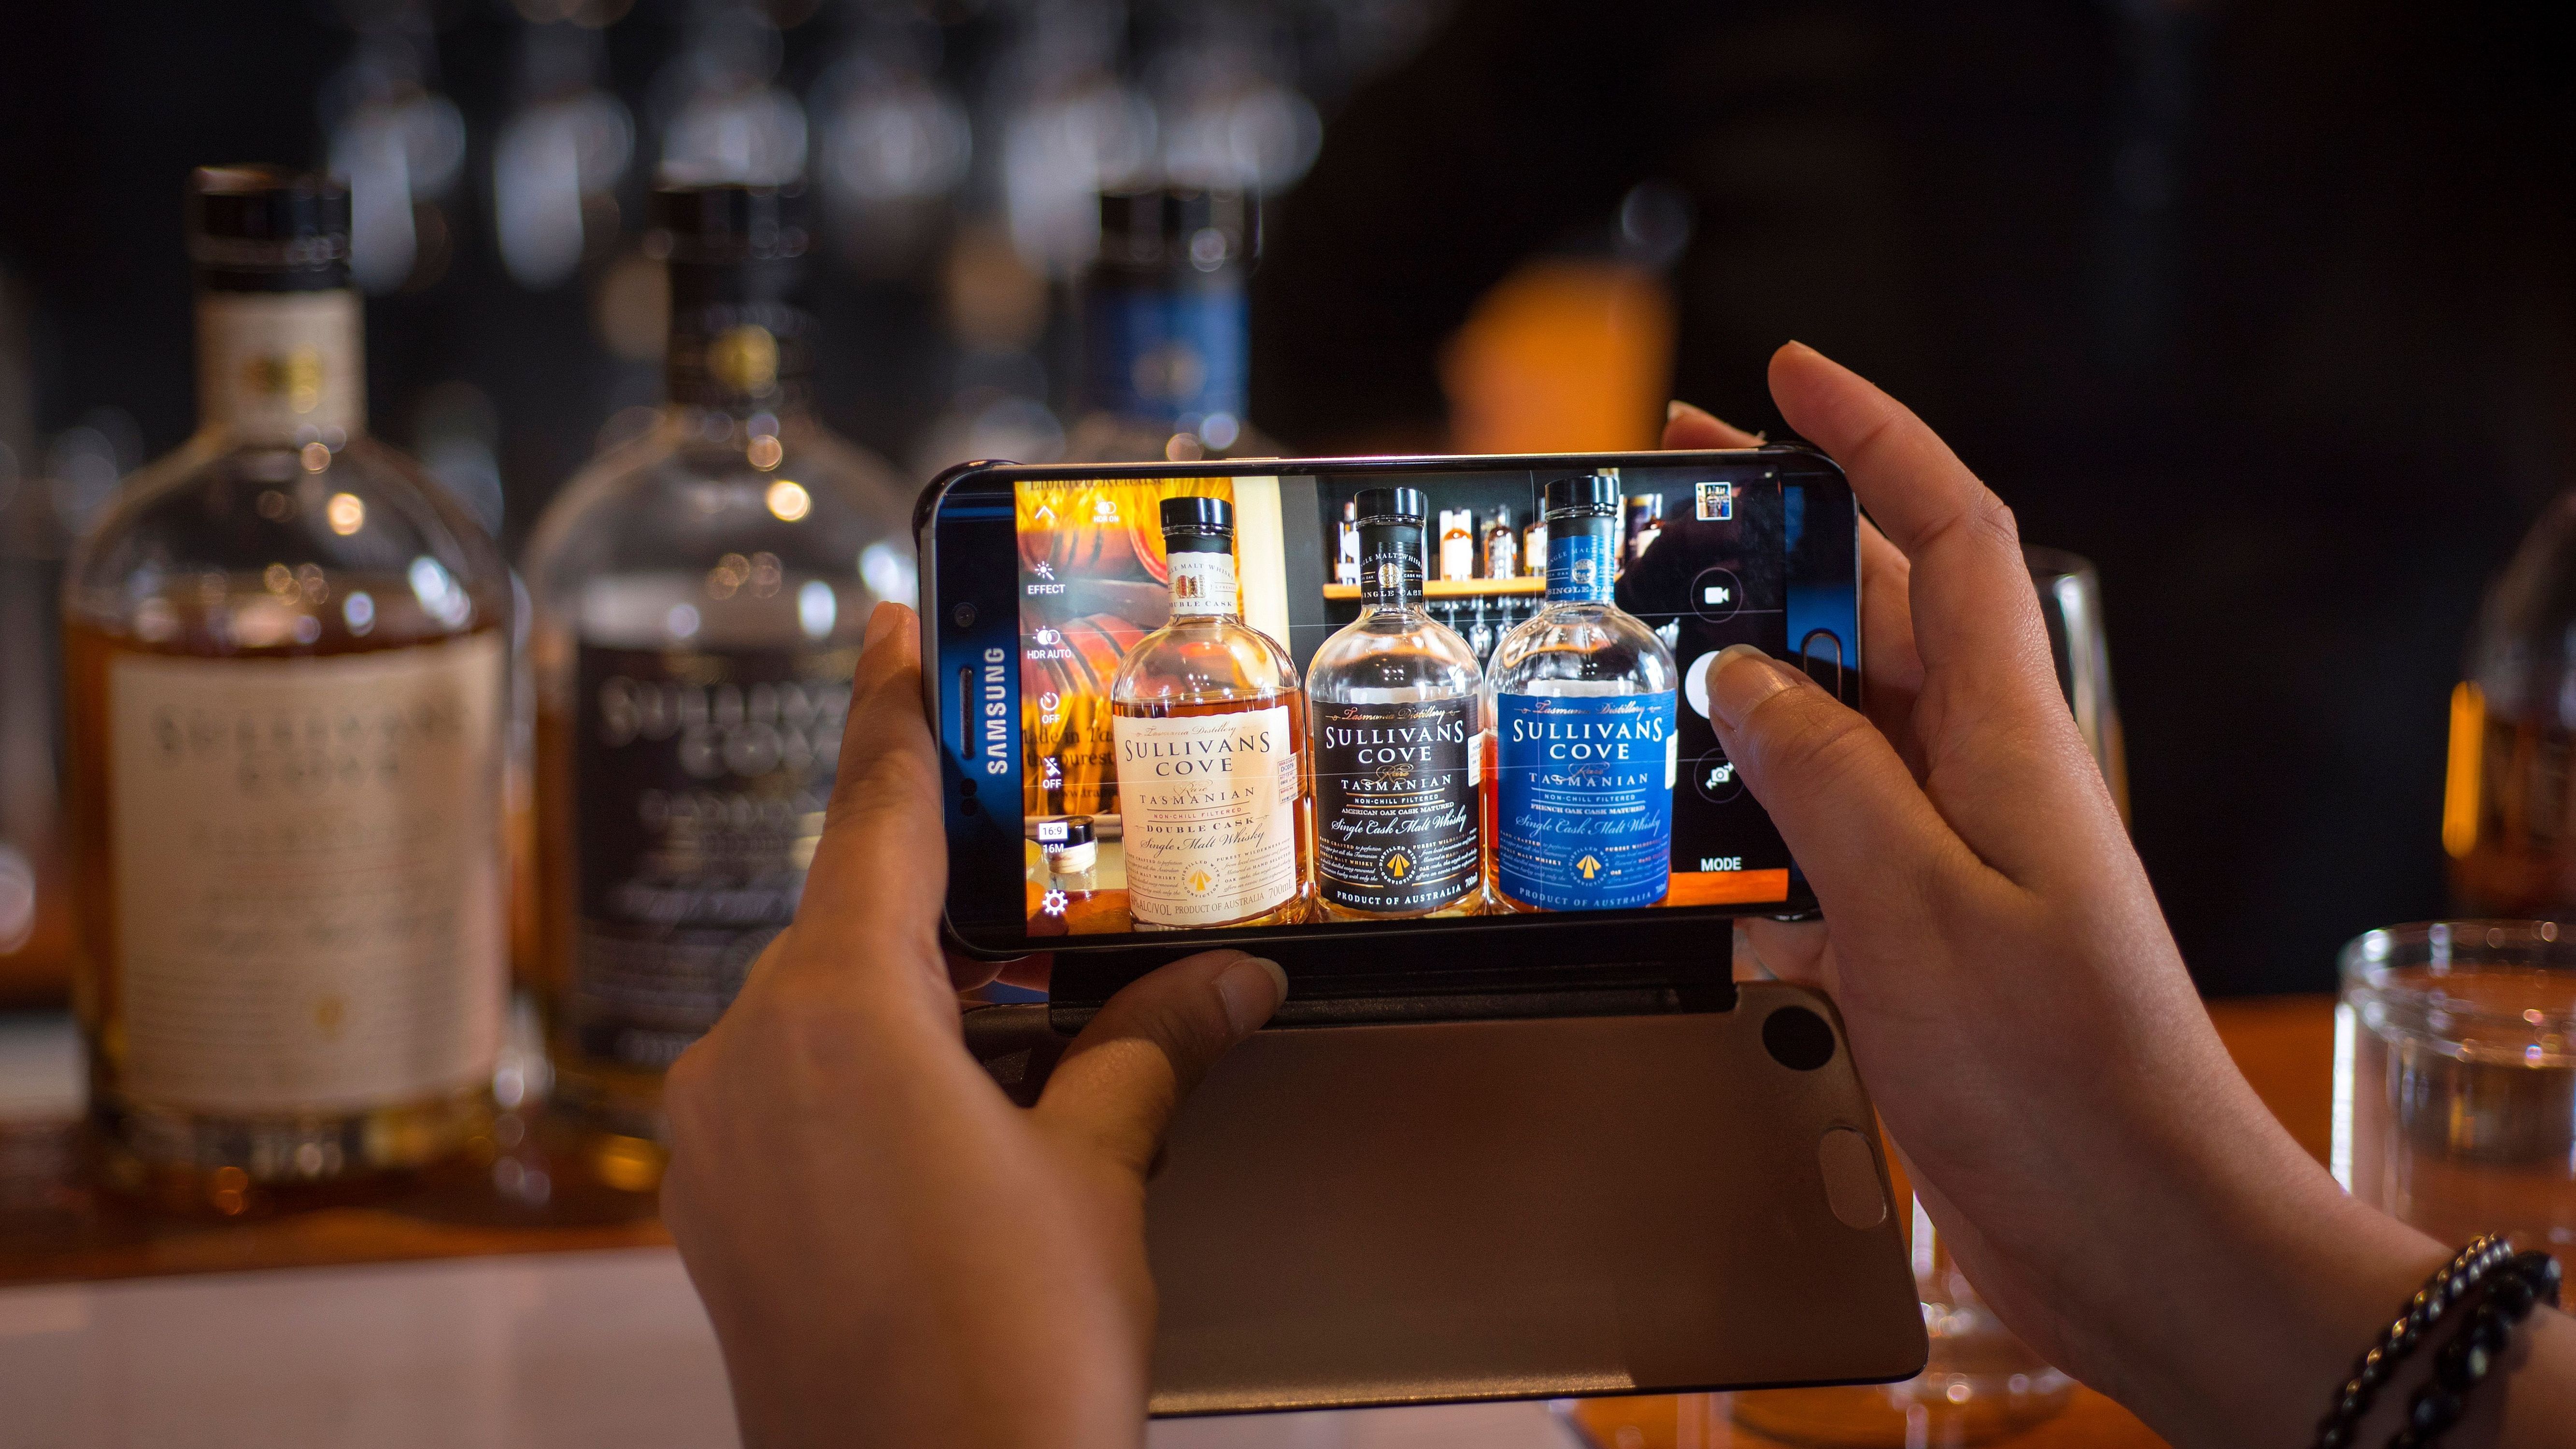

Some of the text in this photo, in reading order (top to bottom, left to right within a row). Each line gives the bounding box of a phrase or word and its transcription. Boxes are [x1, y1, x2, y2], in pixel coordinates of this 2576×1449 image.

[1027, 584, 1065, 594] EFFECT
[1362, 590, 1395, 598] INGLE
[1548, 586, 1590, 595] SINGLE
[1027, 649, 1071, 659] HDR AUTO
[984, 648, 1008, 775] SAMSUNG
[1342, 705, 1445, 725] Tasmania Distillery
[1595, 700, 1645, 721] Distillery
[1041, 714, 1060, 724] OFF
[1144, 720, 1237, 738] Tasmania Distillery
[1326, 720, 1464, 749] SULLIVANS
[1513, 717, 1663, 742] SULLIVANS
[1125, 731, 1270, 762] SULLIVANS
[1550, 743, 1630, 760] COVE
[1358, 746, 1432, 764] COVE
[1155, 757, 1233, 776] COVE
[1281, 763, 1294, 772] DC079
[1043, 779, 1062, 789] OFF
[1341, 774, 1452, 792] TASMANIAN
[1529, 772, 1648, 787] TASMANIAN
[1139, 787, 1255, 805] TASMANIAN
[1402, 794, 1439, 804] FILTERED
[1544, 794, 1636, 803] NON-CHILL FILTERED
[1201, 807, 1242, 818] FILTERED
[1420, 801, 1454, 814] MATURED
[1530, 803, 1564, 813] FRENCH
[1609, 804, 1646, 815] MATURED
[1147, 817, 1255, 833] DOUBLE CASK
[1331, 805, 1467, 841] Single Cask Malt Whisky
[1516, 809, 1661, 838] Single Cask Malt Whisky
[1042, 827, 1063, 836] 16:9
[1140, 822, 1266, 858] Single Malt Whisky
[1331, 841, 1354, 849] CRAFTED
[1413, 841, 1437, 850] PUREST
[1043, 843, 1064, 853] 16M
[1217, 853, 1241, 862] PUREST
[1245, 842, 1281, 856] WILDERNESS
[1320, 850, 1333, 859] SINGLE
[1270, 852, 1291, 864] SELECTED
[1379, 845, 1417, 885] DISTILLED WITH CONVICTION
[1535, 856, 1561, 866] WHISKY
[1700, 857, 1742, 872] MODE
[1181, 861, 1208, 881] DISTILLED
[1337, 870, 1349, 879] barley
[1175, 879, 1293, 914] PRODUCT OF AUSTRALIA 700mL
[1184, 884, 1219, 898] CONVICTION
[1337, 891, 1381, 905] PRODUCT
[1404, 884, 1461, 904] AUSTRALIA
[1520, 887, 1568, 905] PRODUCT
[1594, 892, 1651, 907] AUSTRALIA
